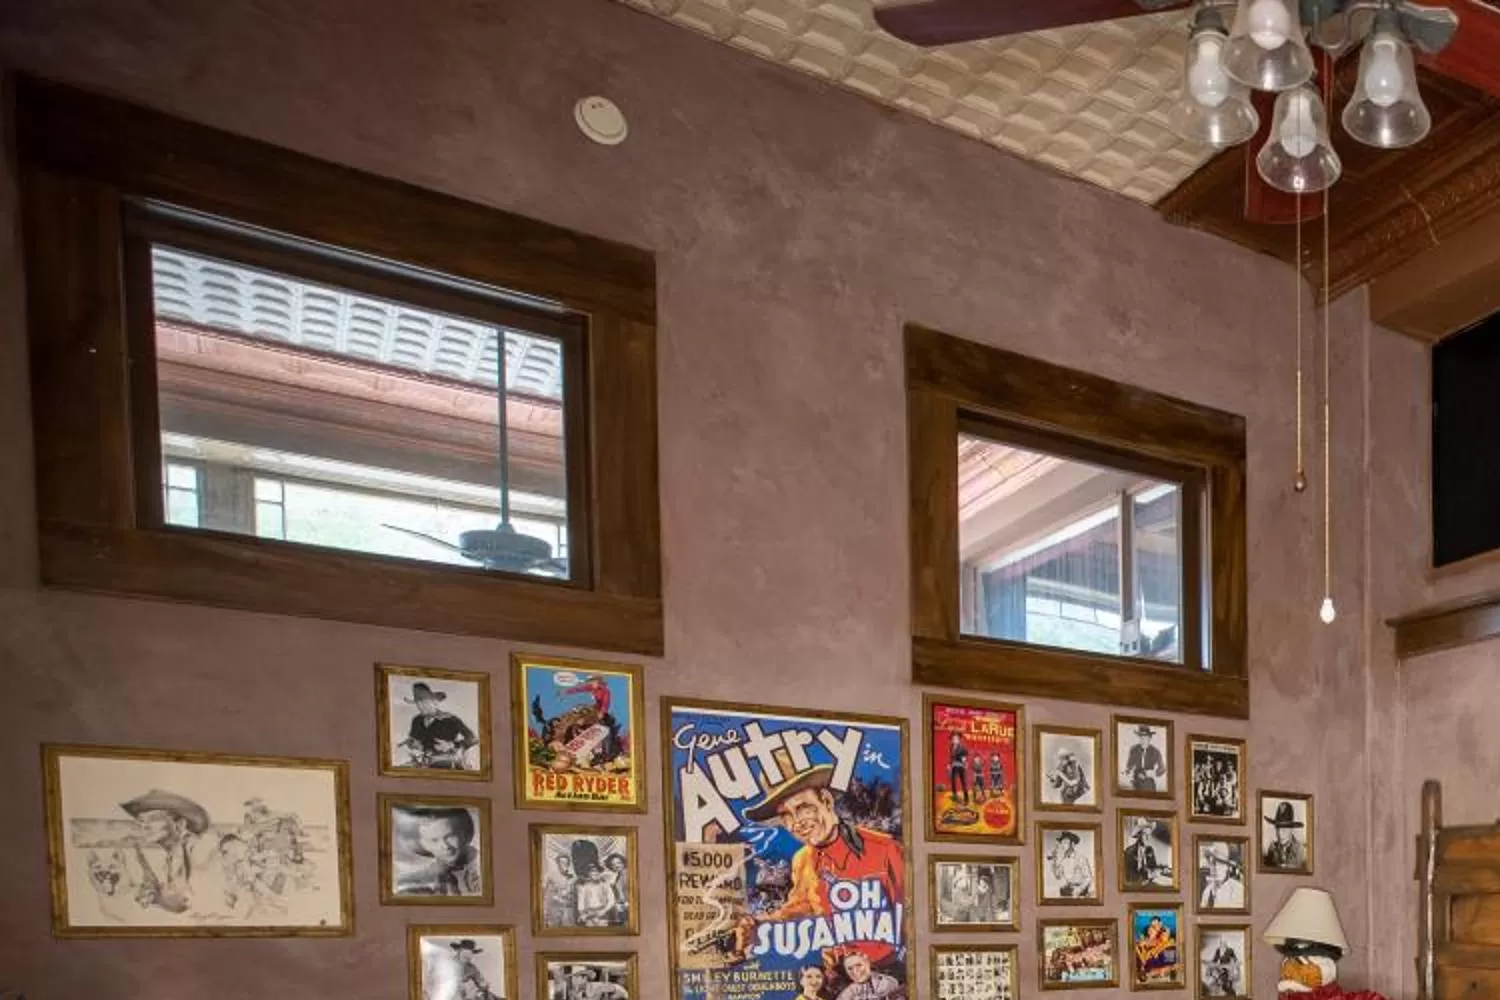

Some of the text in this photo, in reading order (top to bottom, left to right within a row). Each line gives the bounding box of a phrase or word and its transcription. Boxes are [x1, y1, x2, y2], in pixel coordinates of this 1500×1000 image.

[672, 723, 742, 773] Gene
[531, 770, 630, 795] RED RYDER
[680, 873, 742, 890] REWRD
